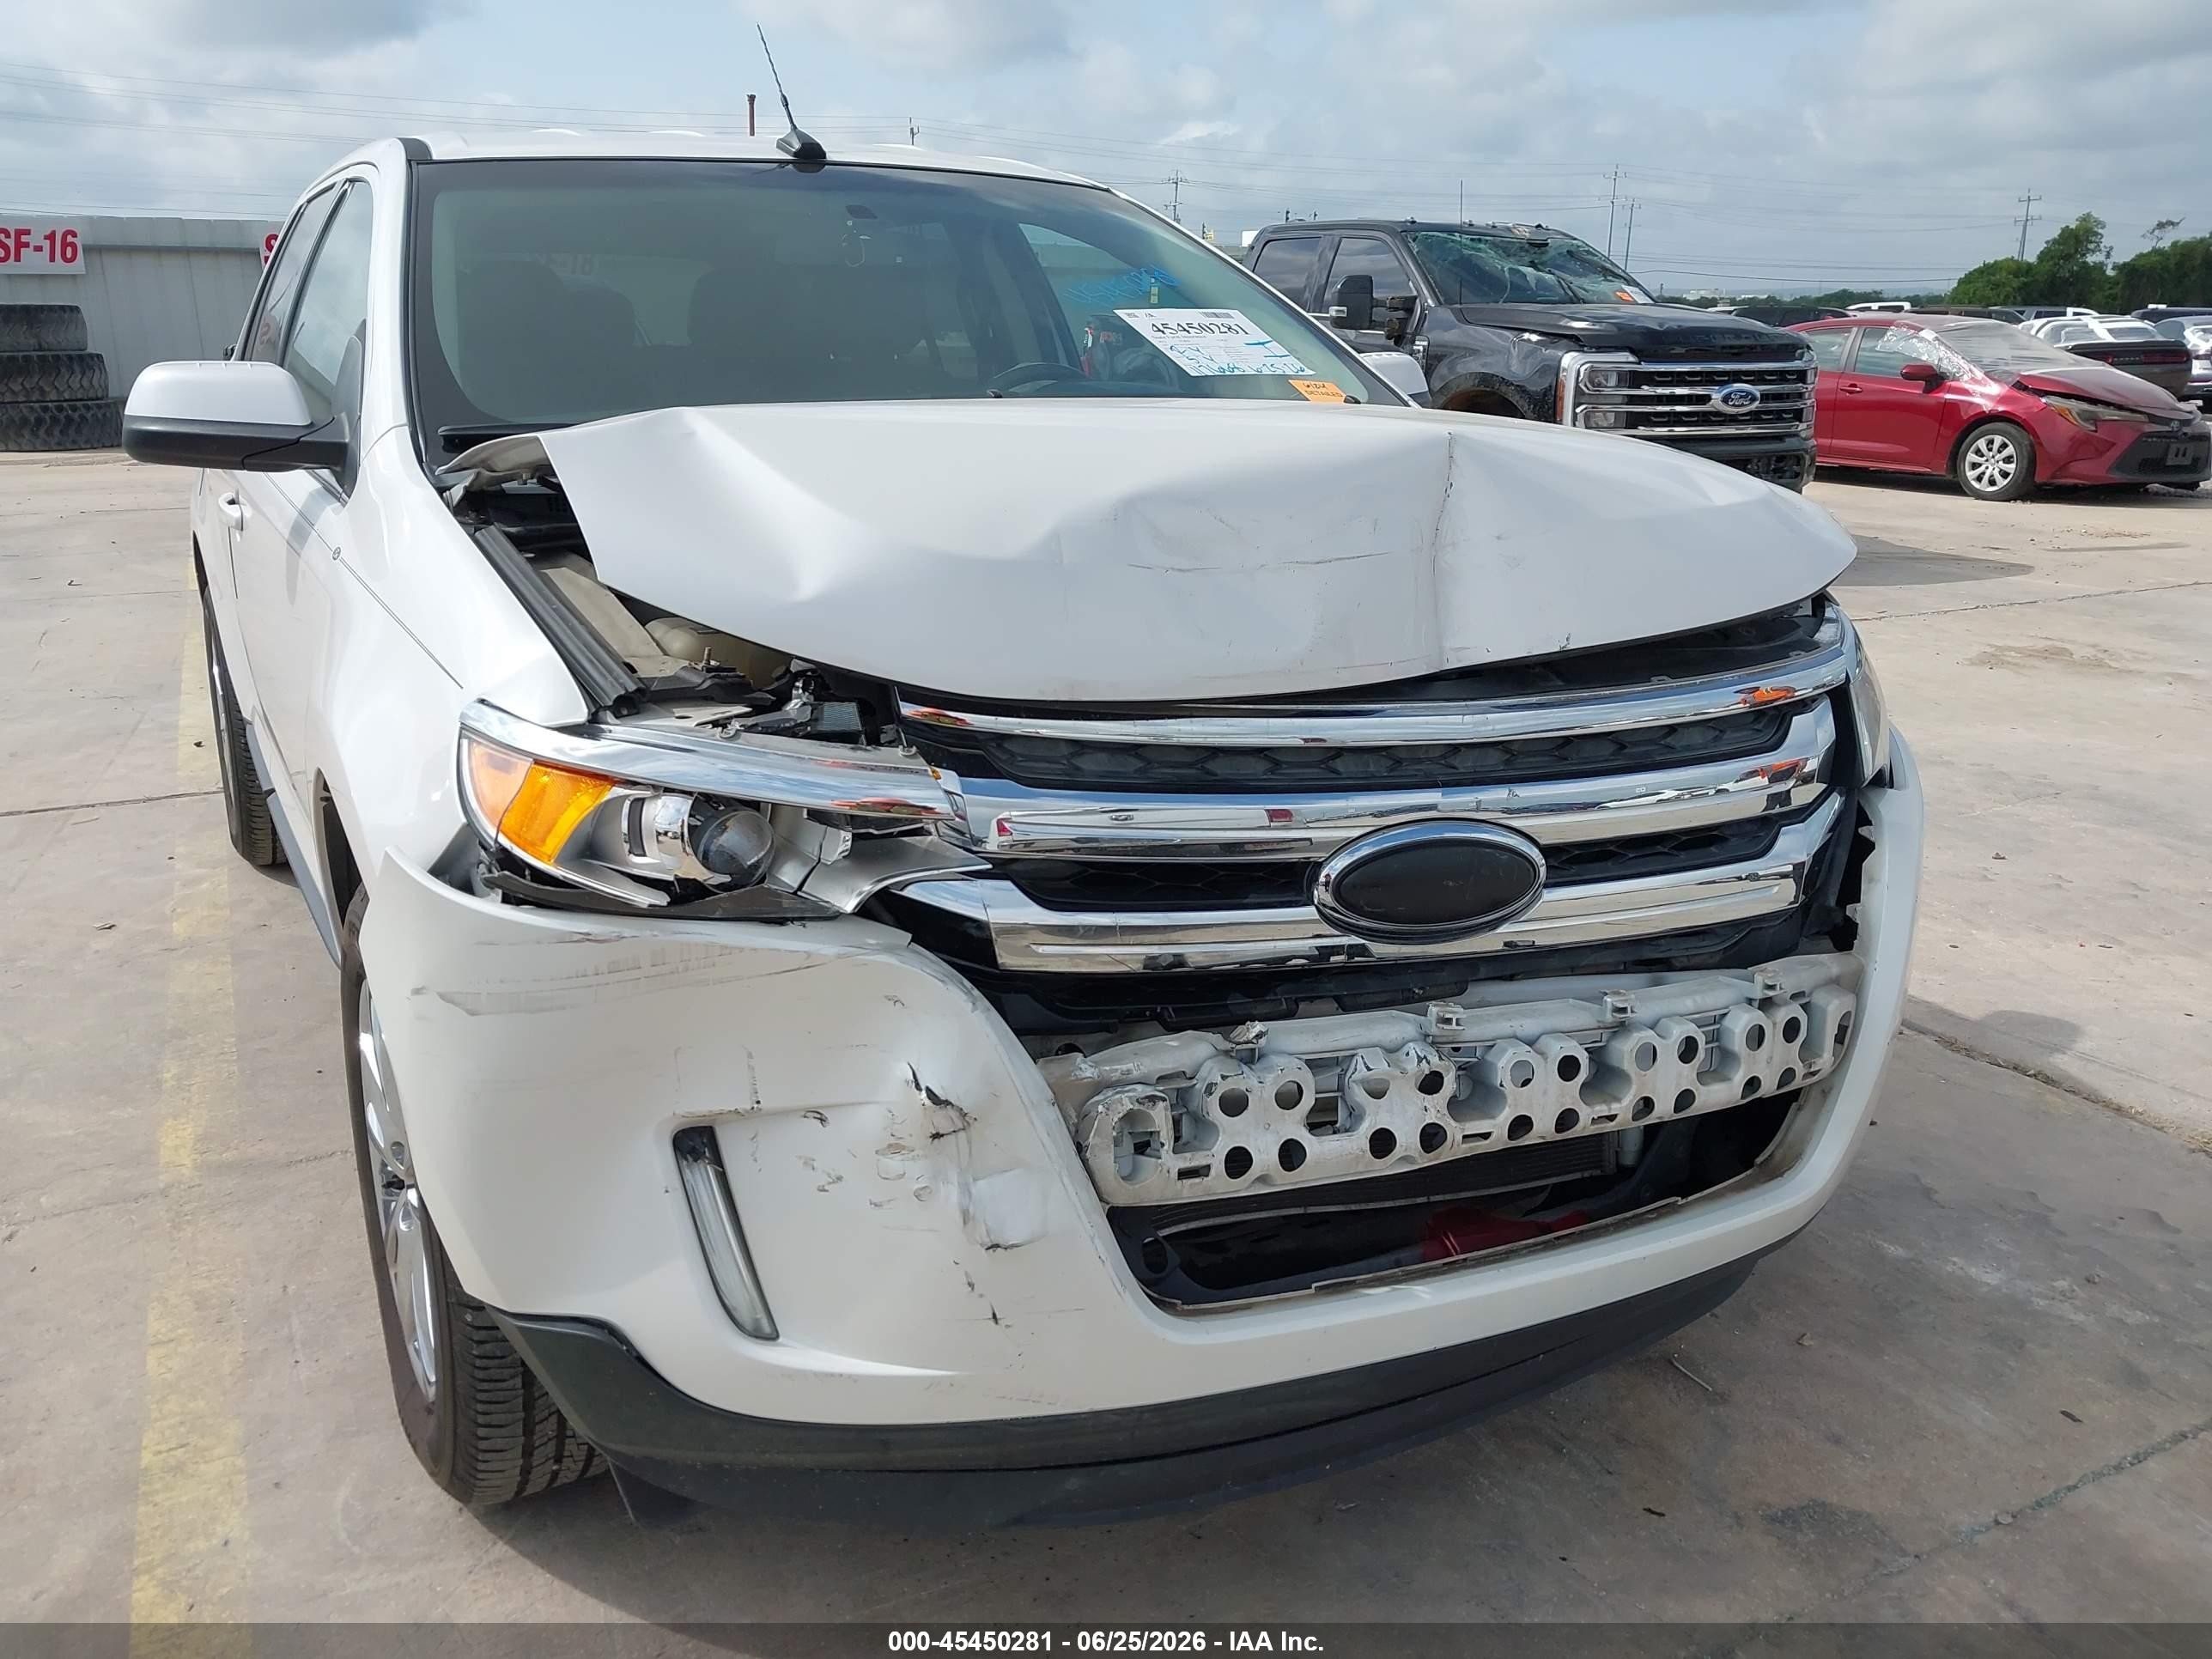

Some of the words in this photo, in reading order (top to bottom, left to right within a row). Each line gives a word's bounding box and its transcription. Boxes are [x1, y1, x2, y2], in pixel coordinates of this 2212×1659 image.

[0, 228, 78, 264] SF-16
[1151, 322, 1251, 336] 45450281
[1728, 392, 1752, 406] Ford
